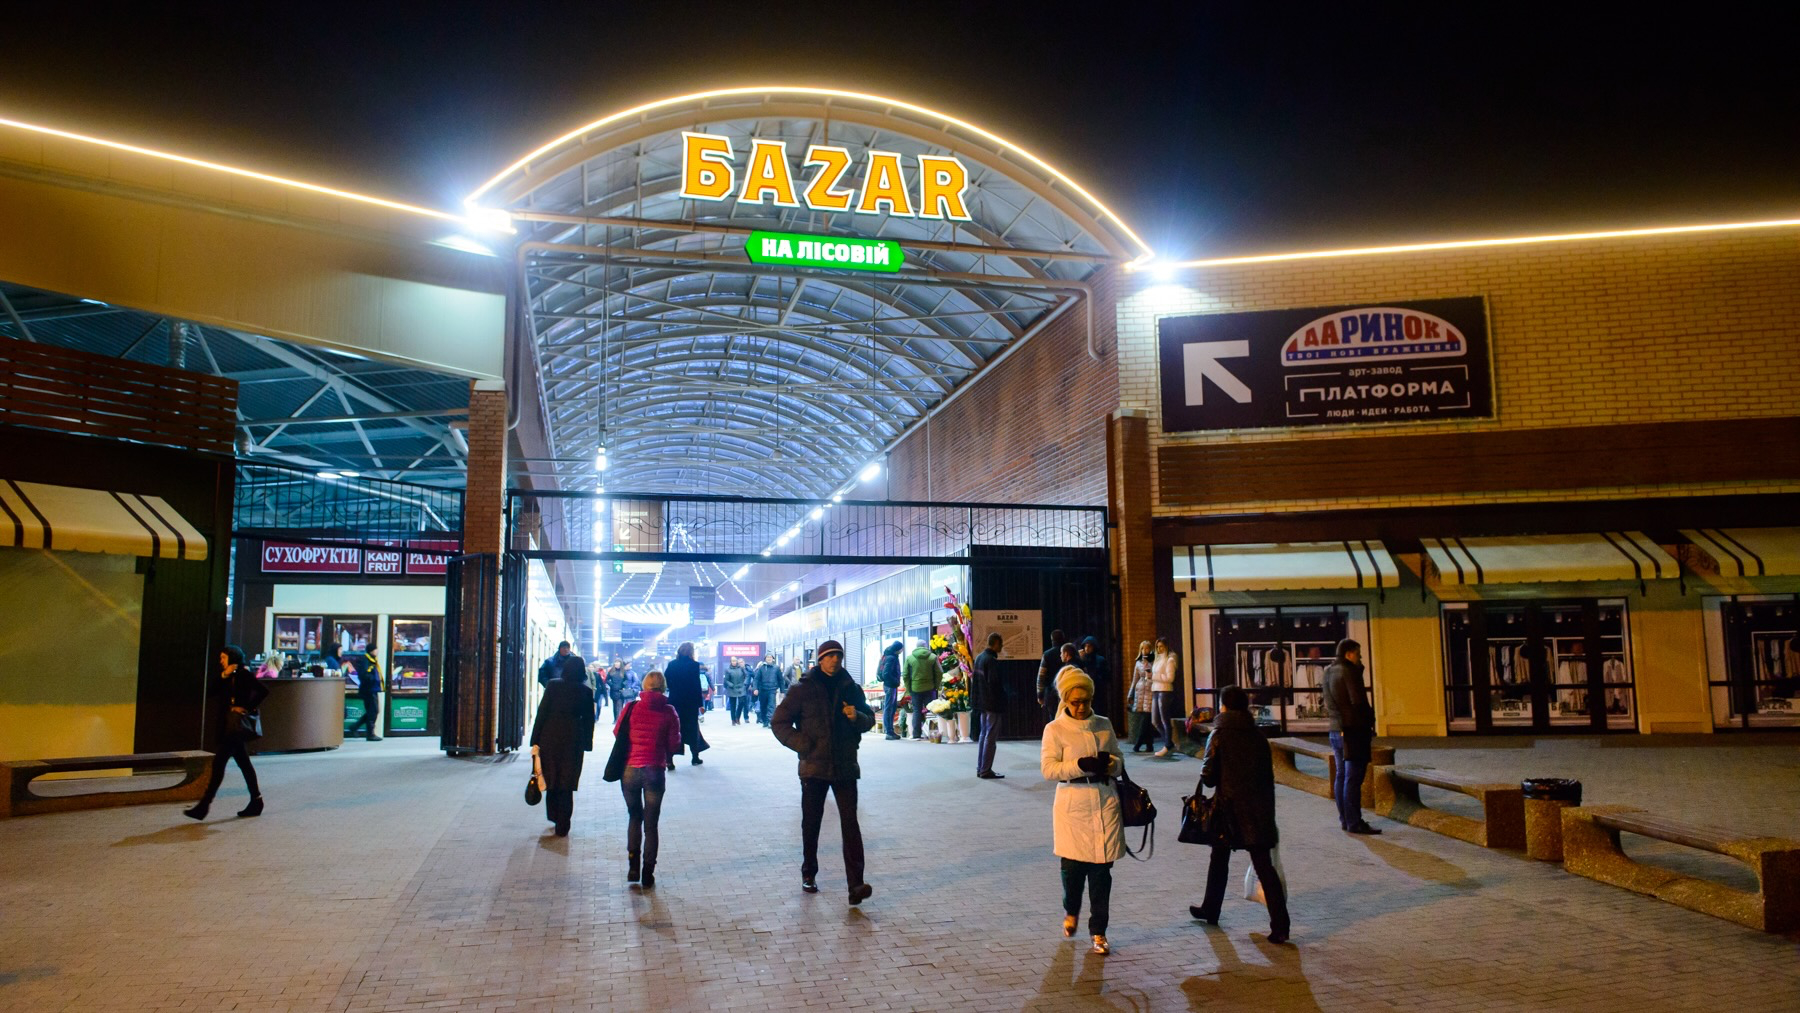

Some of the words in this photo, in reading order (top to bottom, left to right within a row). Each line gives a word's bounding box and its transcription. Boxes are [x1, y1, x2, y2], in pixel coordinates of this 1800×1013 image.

[762, 238, 794, 258] НА
[797, 241, 889, 265] ЛІСОВІЙ
[1348, 366, 1403, 377] арт-завод
[1300, 380, 1455, 402] ПЛАТФОРМА
[1326, 408, 1355, 418] ЛЮДИ
[1361, 407, 1388, 417] ИДЕИ
[1394, 405, 1430, 414] РАБОТА
[265, 546, 358, 564] СУХОФРУКТИ
[367, 552, 399, 562] KAND
[409, 553, 447, 565] РАХА
[368, 563, 399, 572] FRUT
